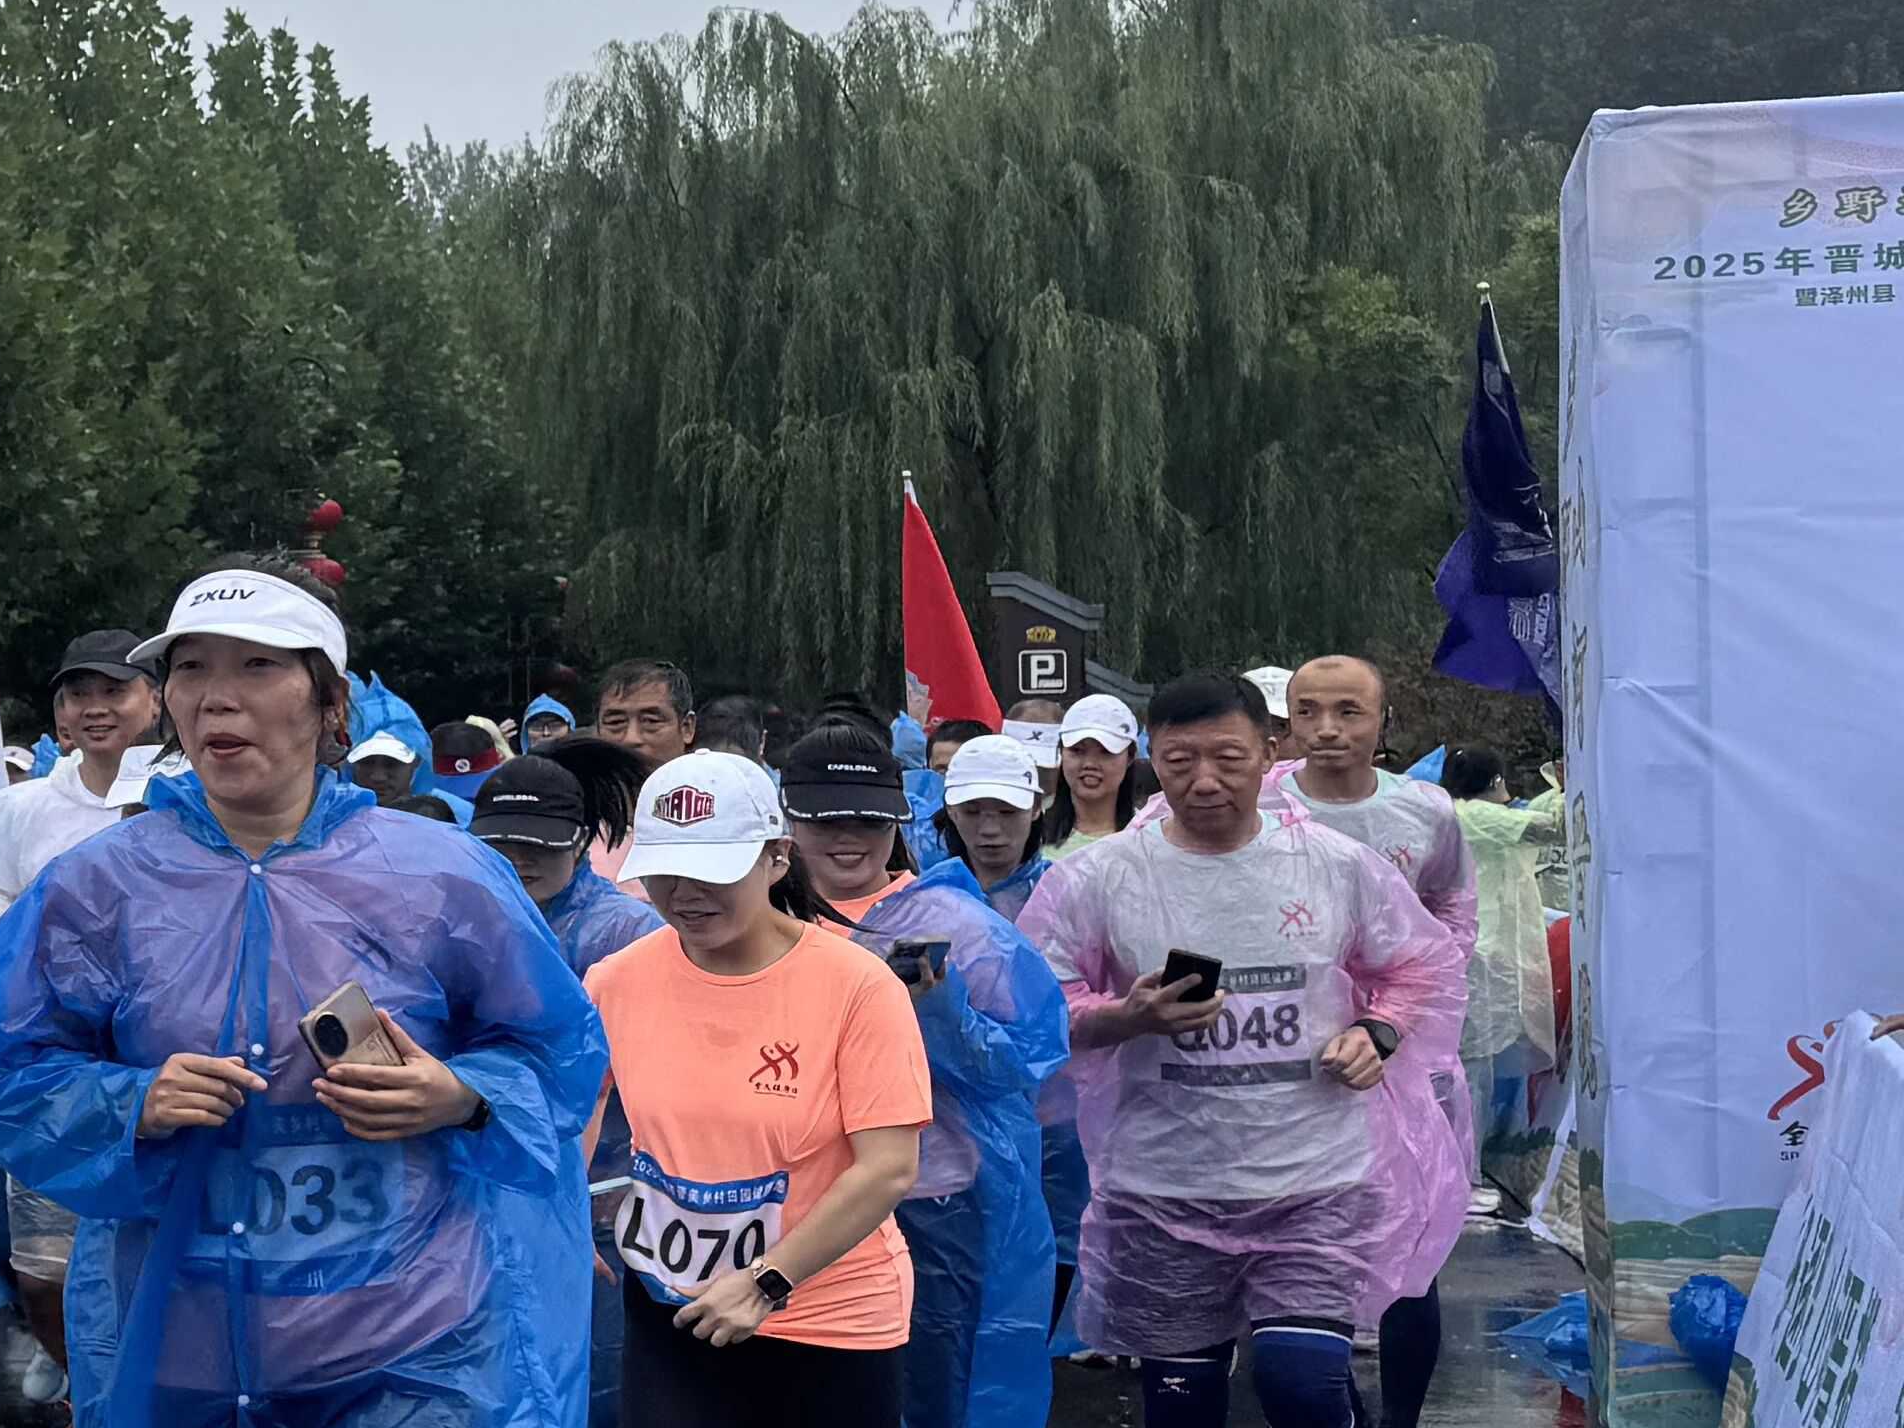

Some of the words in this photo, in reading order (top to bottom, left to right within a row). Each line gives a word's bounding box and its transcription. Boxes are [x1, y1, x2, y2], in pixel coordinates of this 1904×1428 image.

[1779, 186, 1904, 228] 乡野
[1795, 284, 1896, 308] 暨泽州县
[1030, 654, 1055, 689] P
